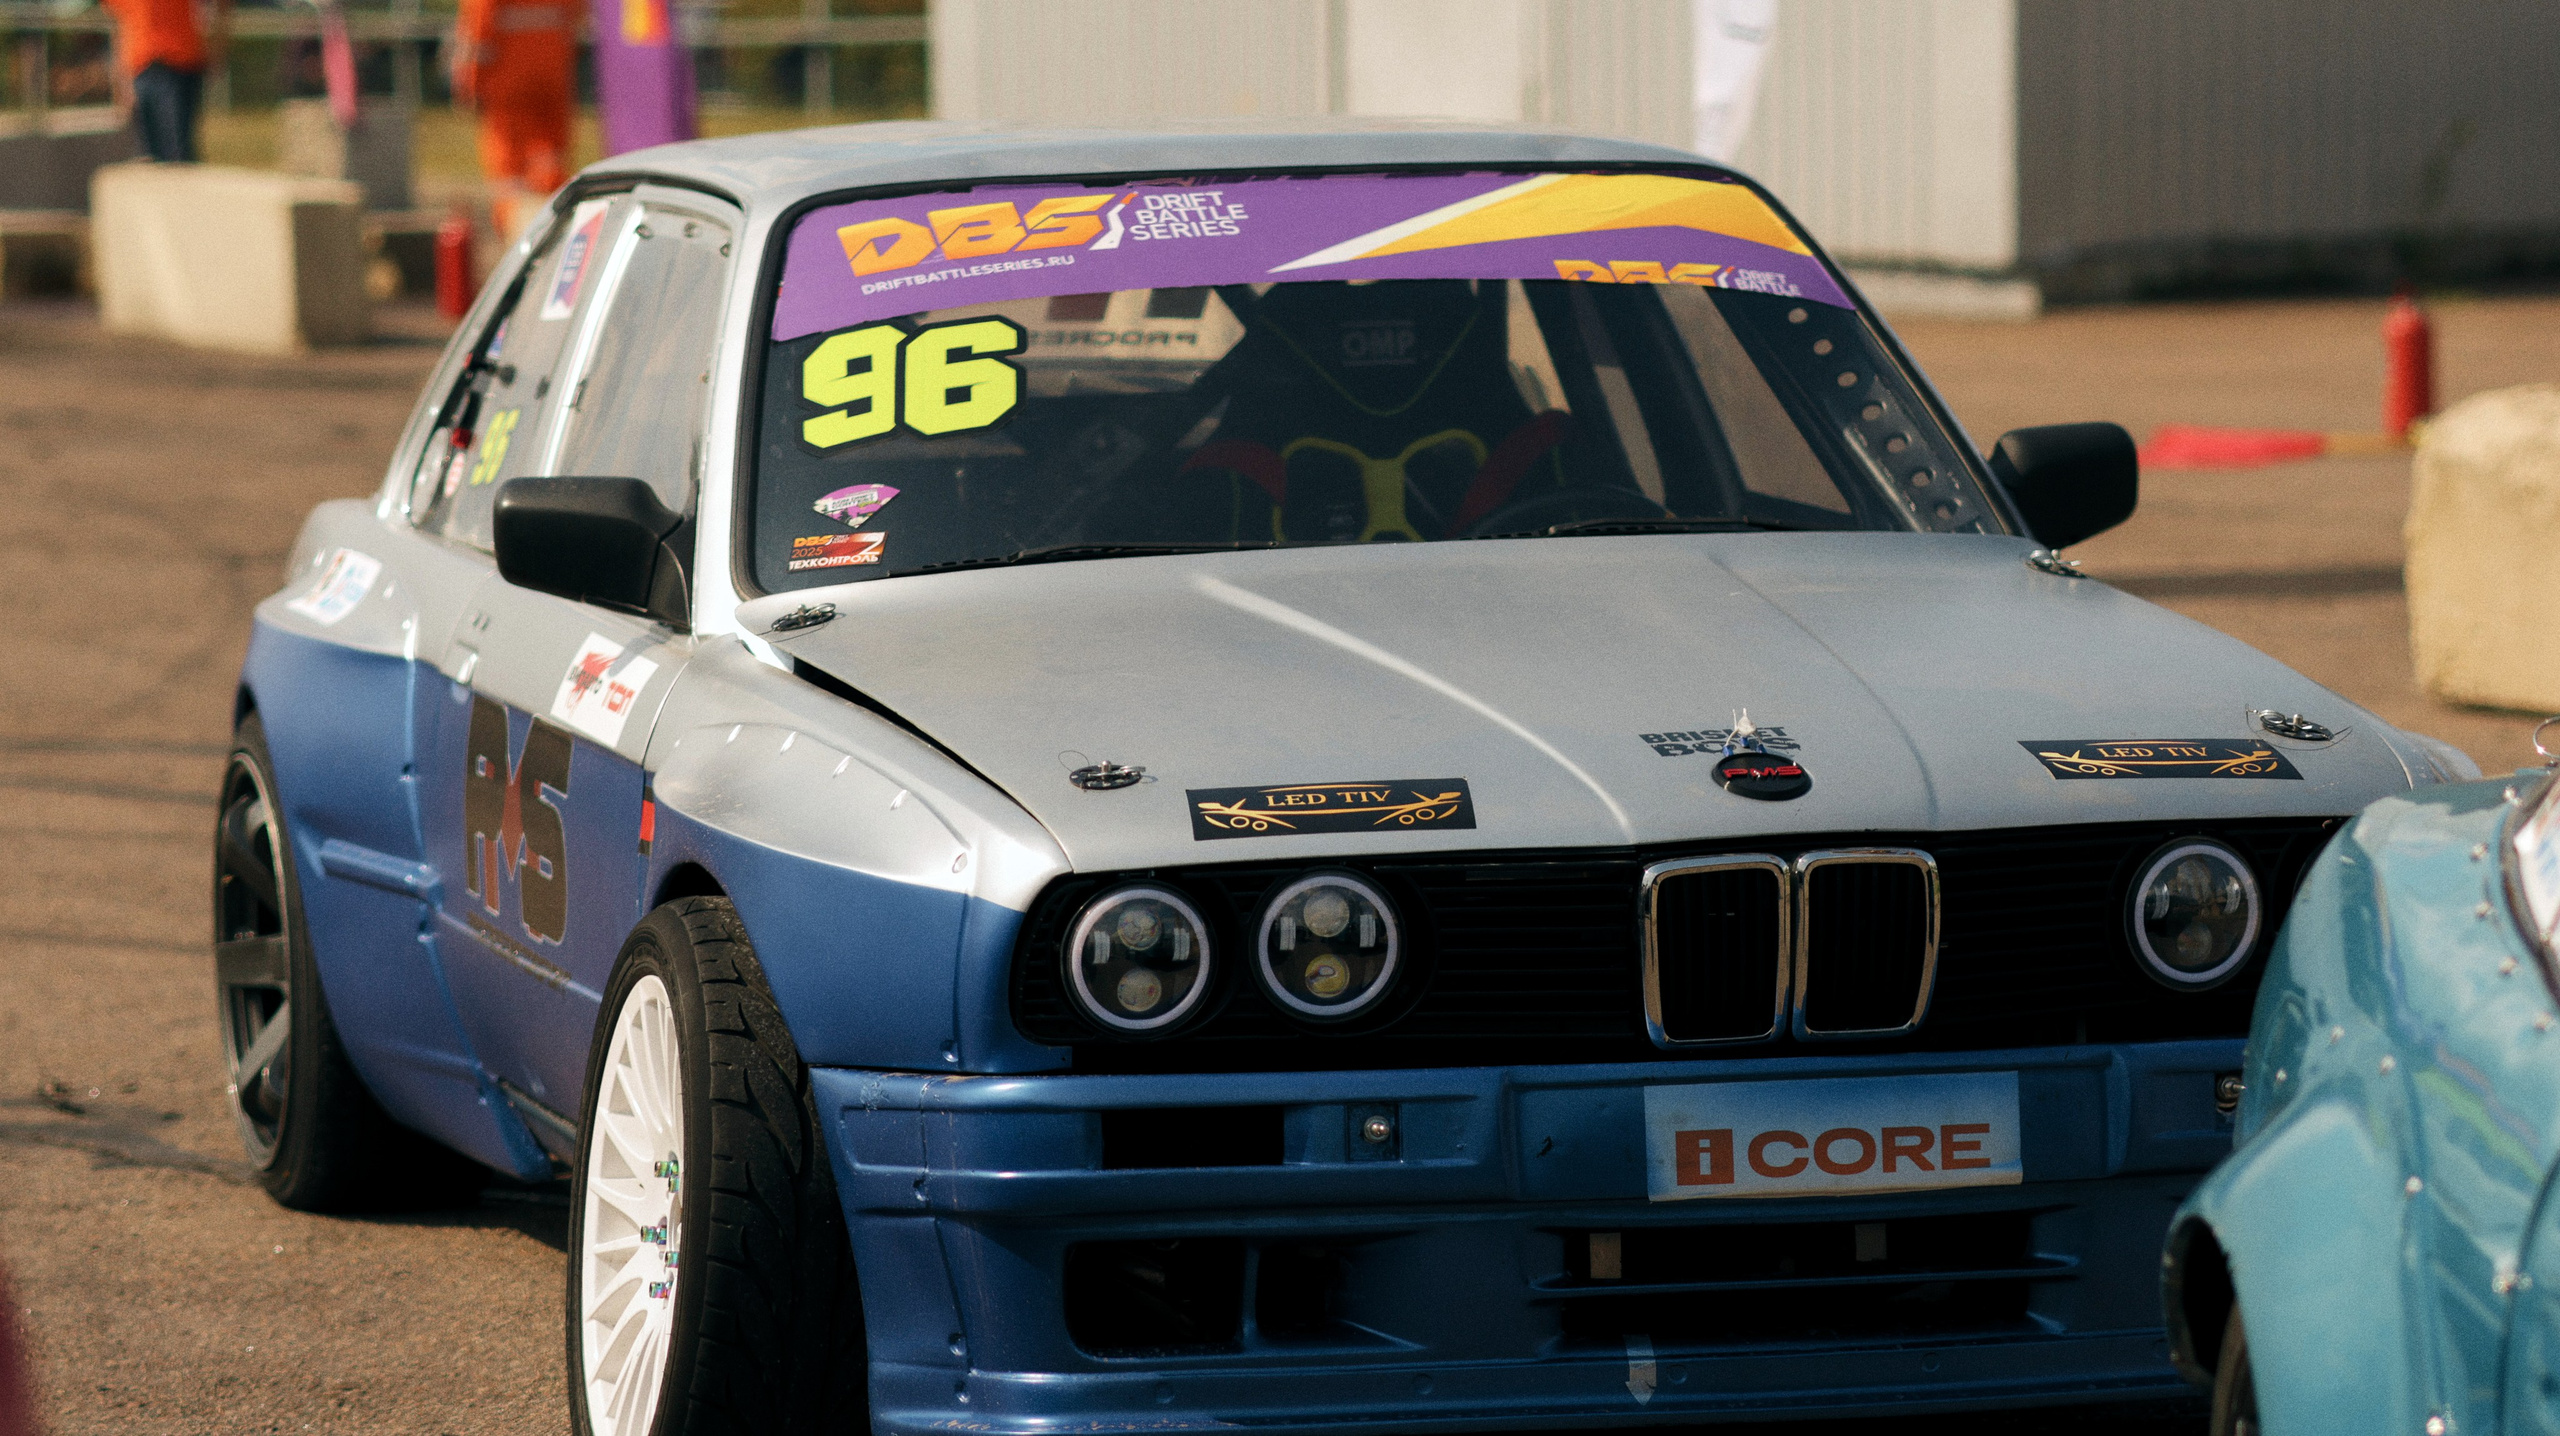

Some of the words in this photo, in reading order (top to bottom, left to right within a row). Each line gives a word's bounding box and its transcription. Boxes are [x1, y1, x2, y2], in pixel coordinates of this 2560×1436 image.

[1143, 191, 1223, 210] DRIFT
[1135, 204, 1249, 225] BATTLE
[837, 194, 1116, 277] DBS
[1129, 220, 1240, 241] SERIES
[861, 255, 1076, 295] DRIFTBATTLESERIES.RU
[1738, 268, 1786, 285] DRIFT
[803, 320, 1017, 448] 96
[791, 546, 823, 558] 2025
[789, 555, 879, 571] ТЕХКОНТРОЛЬ
[1651, 738, 1801, 756] BOS
[2096, 747, 2153, 757] LED
[2158, 747, 2207, 757] TIV
[1266, 793, 1327, 807] LED
[1337, 790, 1391, 803] TIV
[1747, 1123, 1991, 1178] CORE
